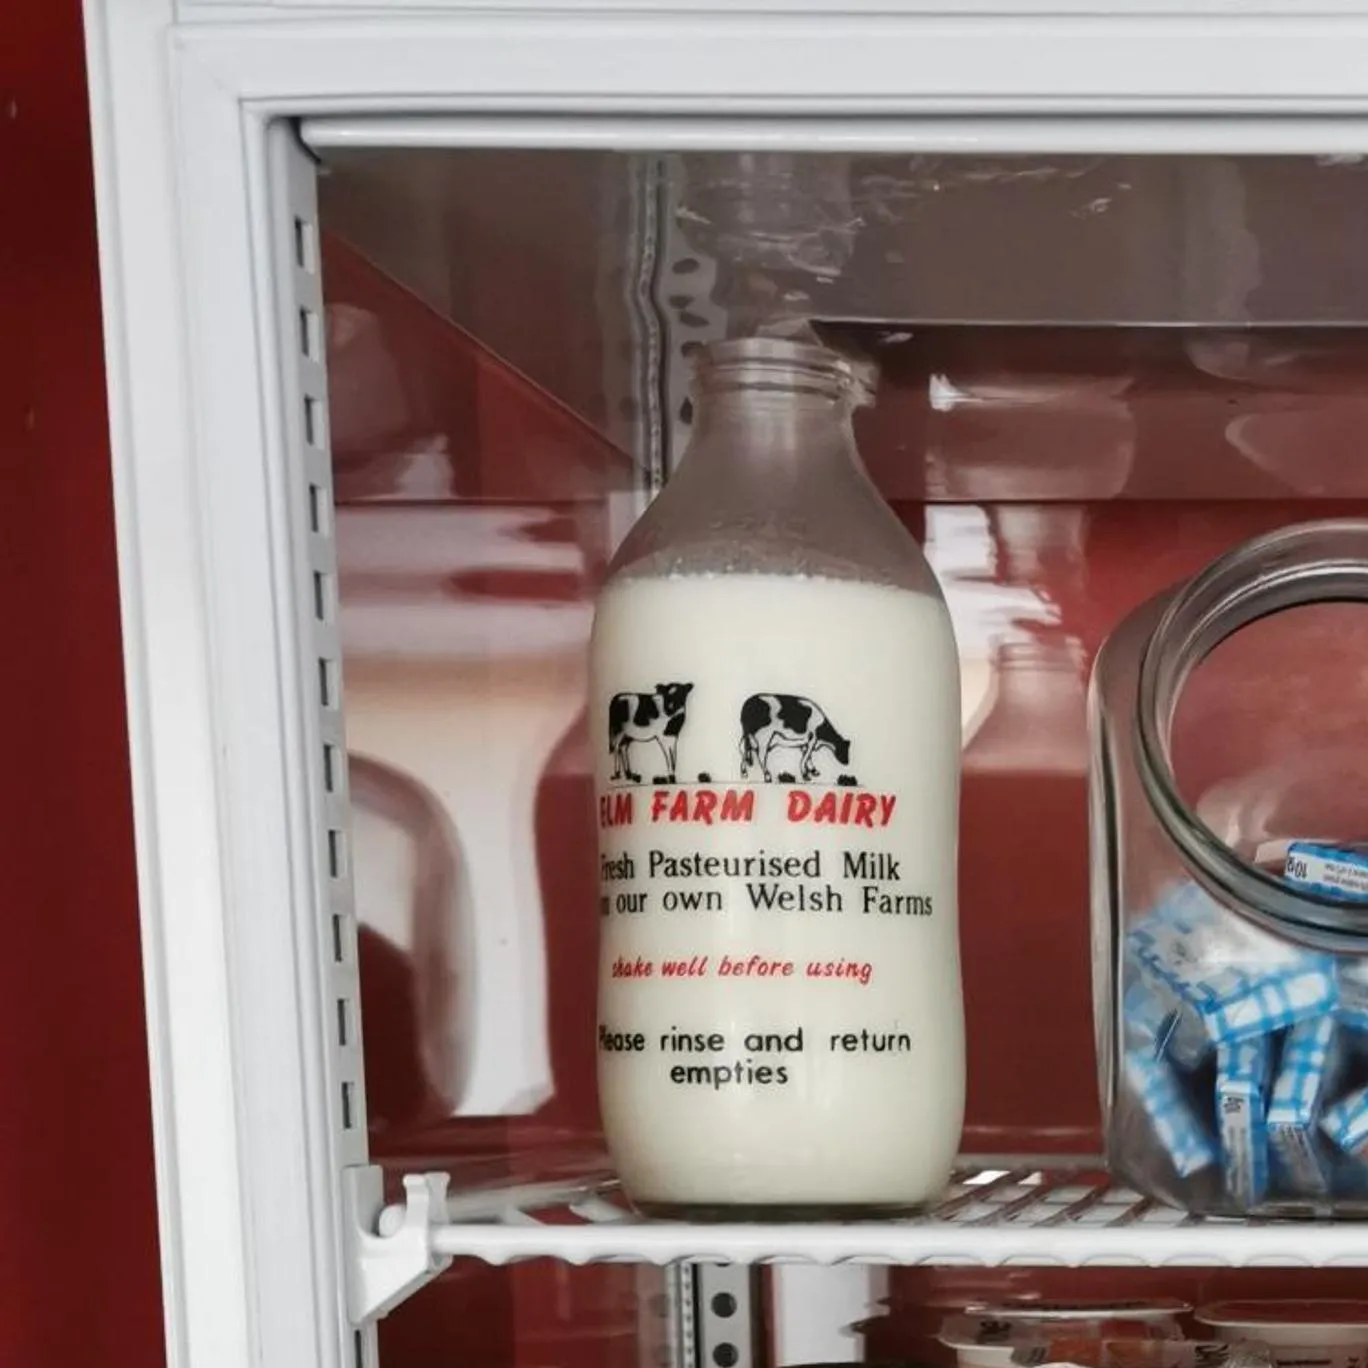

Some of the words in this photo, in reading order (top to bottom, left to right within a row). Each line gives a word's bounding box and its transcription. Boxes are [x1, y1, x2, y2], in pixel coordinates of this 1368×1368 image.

[651, 789, 755, 825] FARM
[786, 790, 897, 829] DAIRY
[649, 850, 821, 879] Pasteurised
[843, 852, 901, 881] Milk
[616, 892, 648, 914] our
[663, 890, 722, 912] own
[746, 883, 844, 913] Welsh
[862, 886, 933, 917] Farms
[661, 955, 708, 977] well
[718, 955, 794, 977] before
[806, 958, 873, 985] using
[660, 1025, 726, 1052] rinse
[744, 1026, 804, 1053] and
[830, 1030, 912, 1053] return
[670, 1060, 789, 1090] empties
